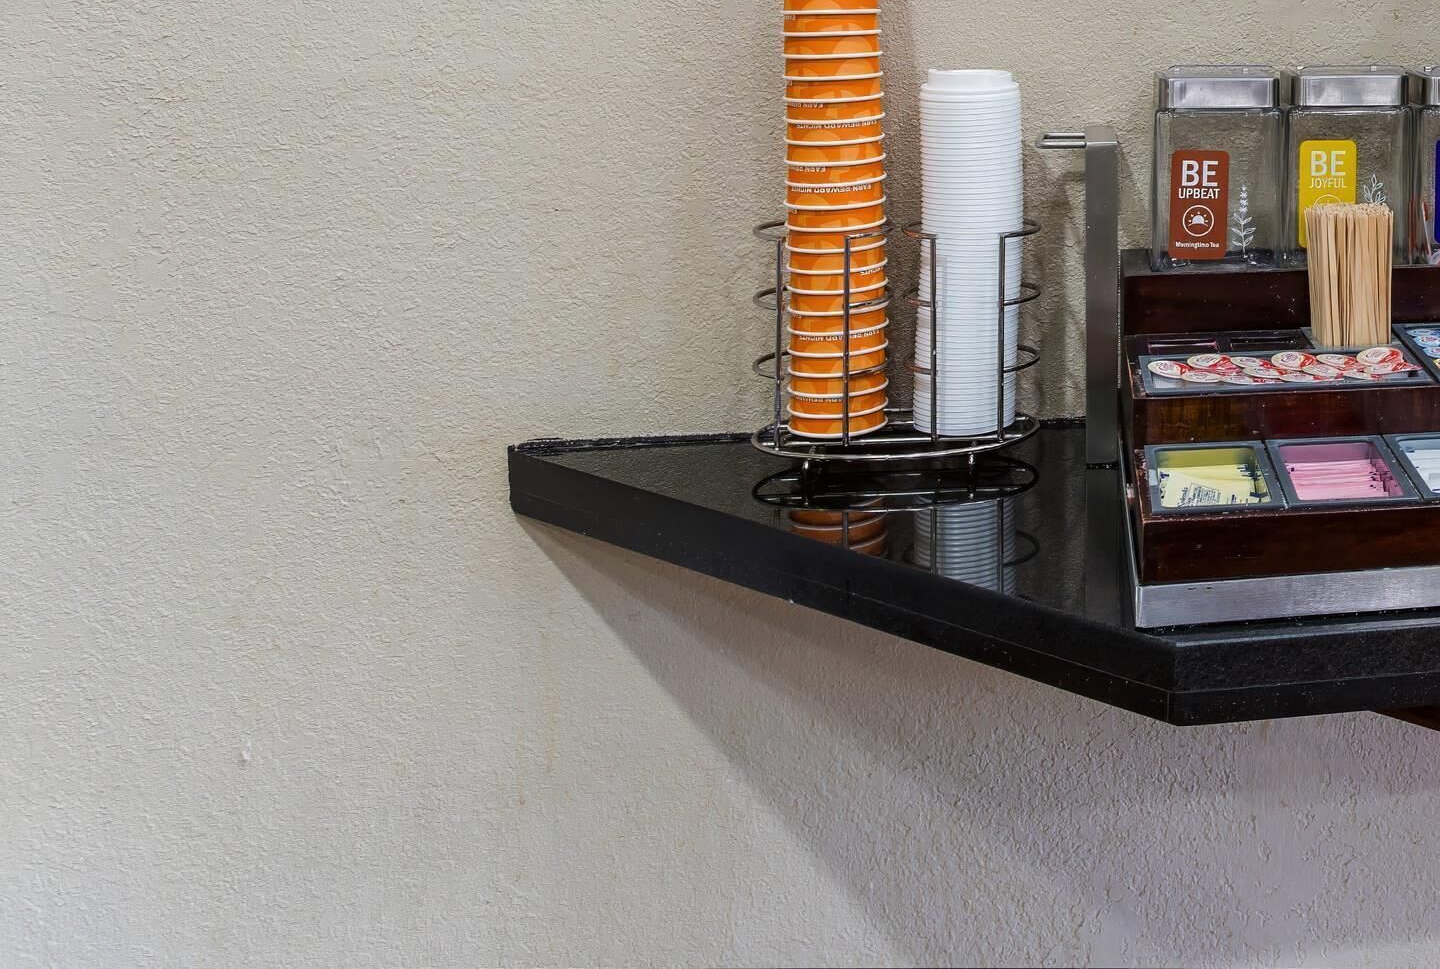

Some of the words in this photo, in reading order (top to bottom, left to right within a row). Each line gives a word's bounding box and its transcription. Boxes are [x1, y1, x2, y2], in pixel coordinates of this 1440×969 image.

[1311, 151, 1345, 176] BE
[1182, 160, 1218, 187] BE
[1310, 178, 1347, 188] JOYFUL
[1179, 188, 1220, 199] UPBEAT
